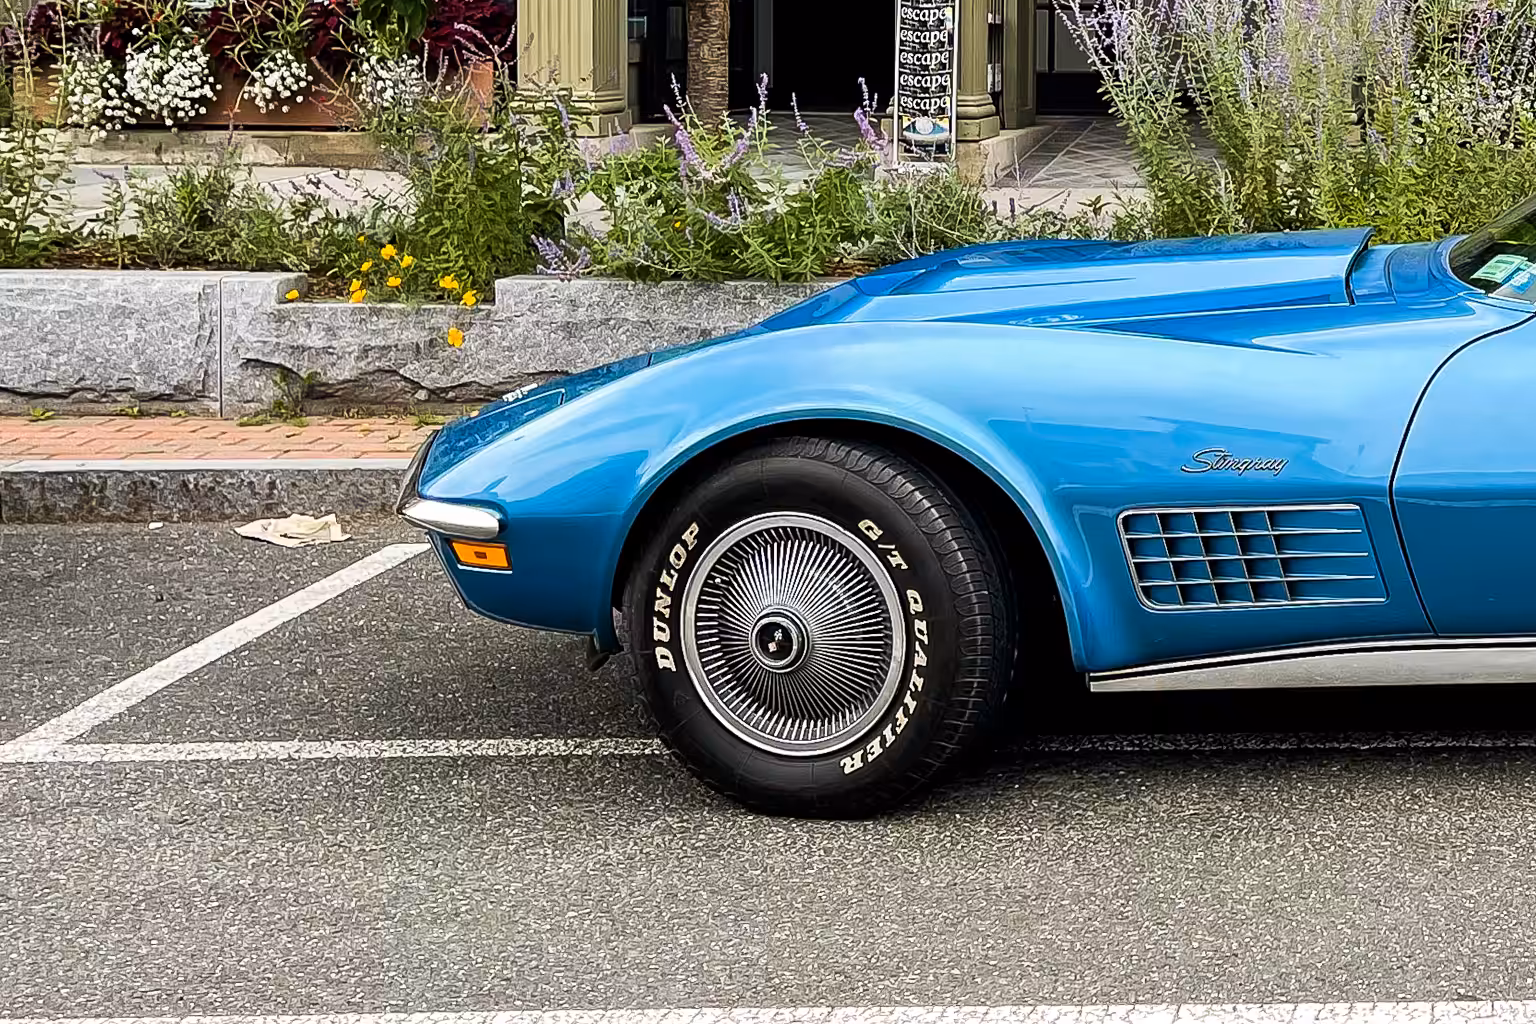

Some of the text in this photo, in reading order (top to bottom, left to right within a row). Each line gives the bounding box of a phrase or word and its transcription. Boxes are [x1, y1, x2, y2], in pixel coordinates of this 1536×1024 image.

[900, 29, 949, 47] escape
[899, 51, 949, 69] escape
[899, 73, 950, 91] escape
[1180, 446, 1290, 477] Stingray
[857, 518, 908, 570] G/T
[652, 521, 699, 673] DUNLOP
[838, 588, 930, 775] QUALIFIER
